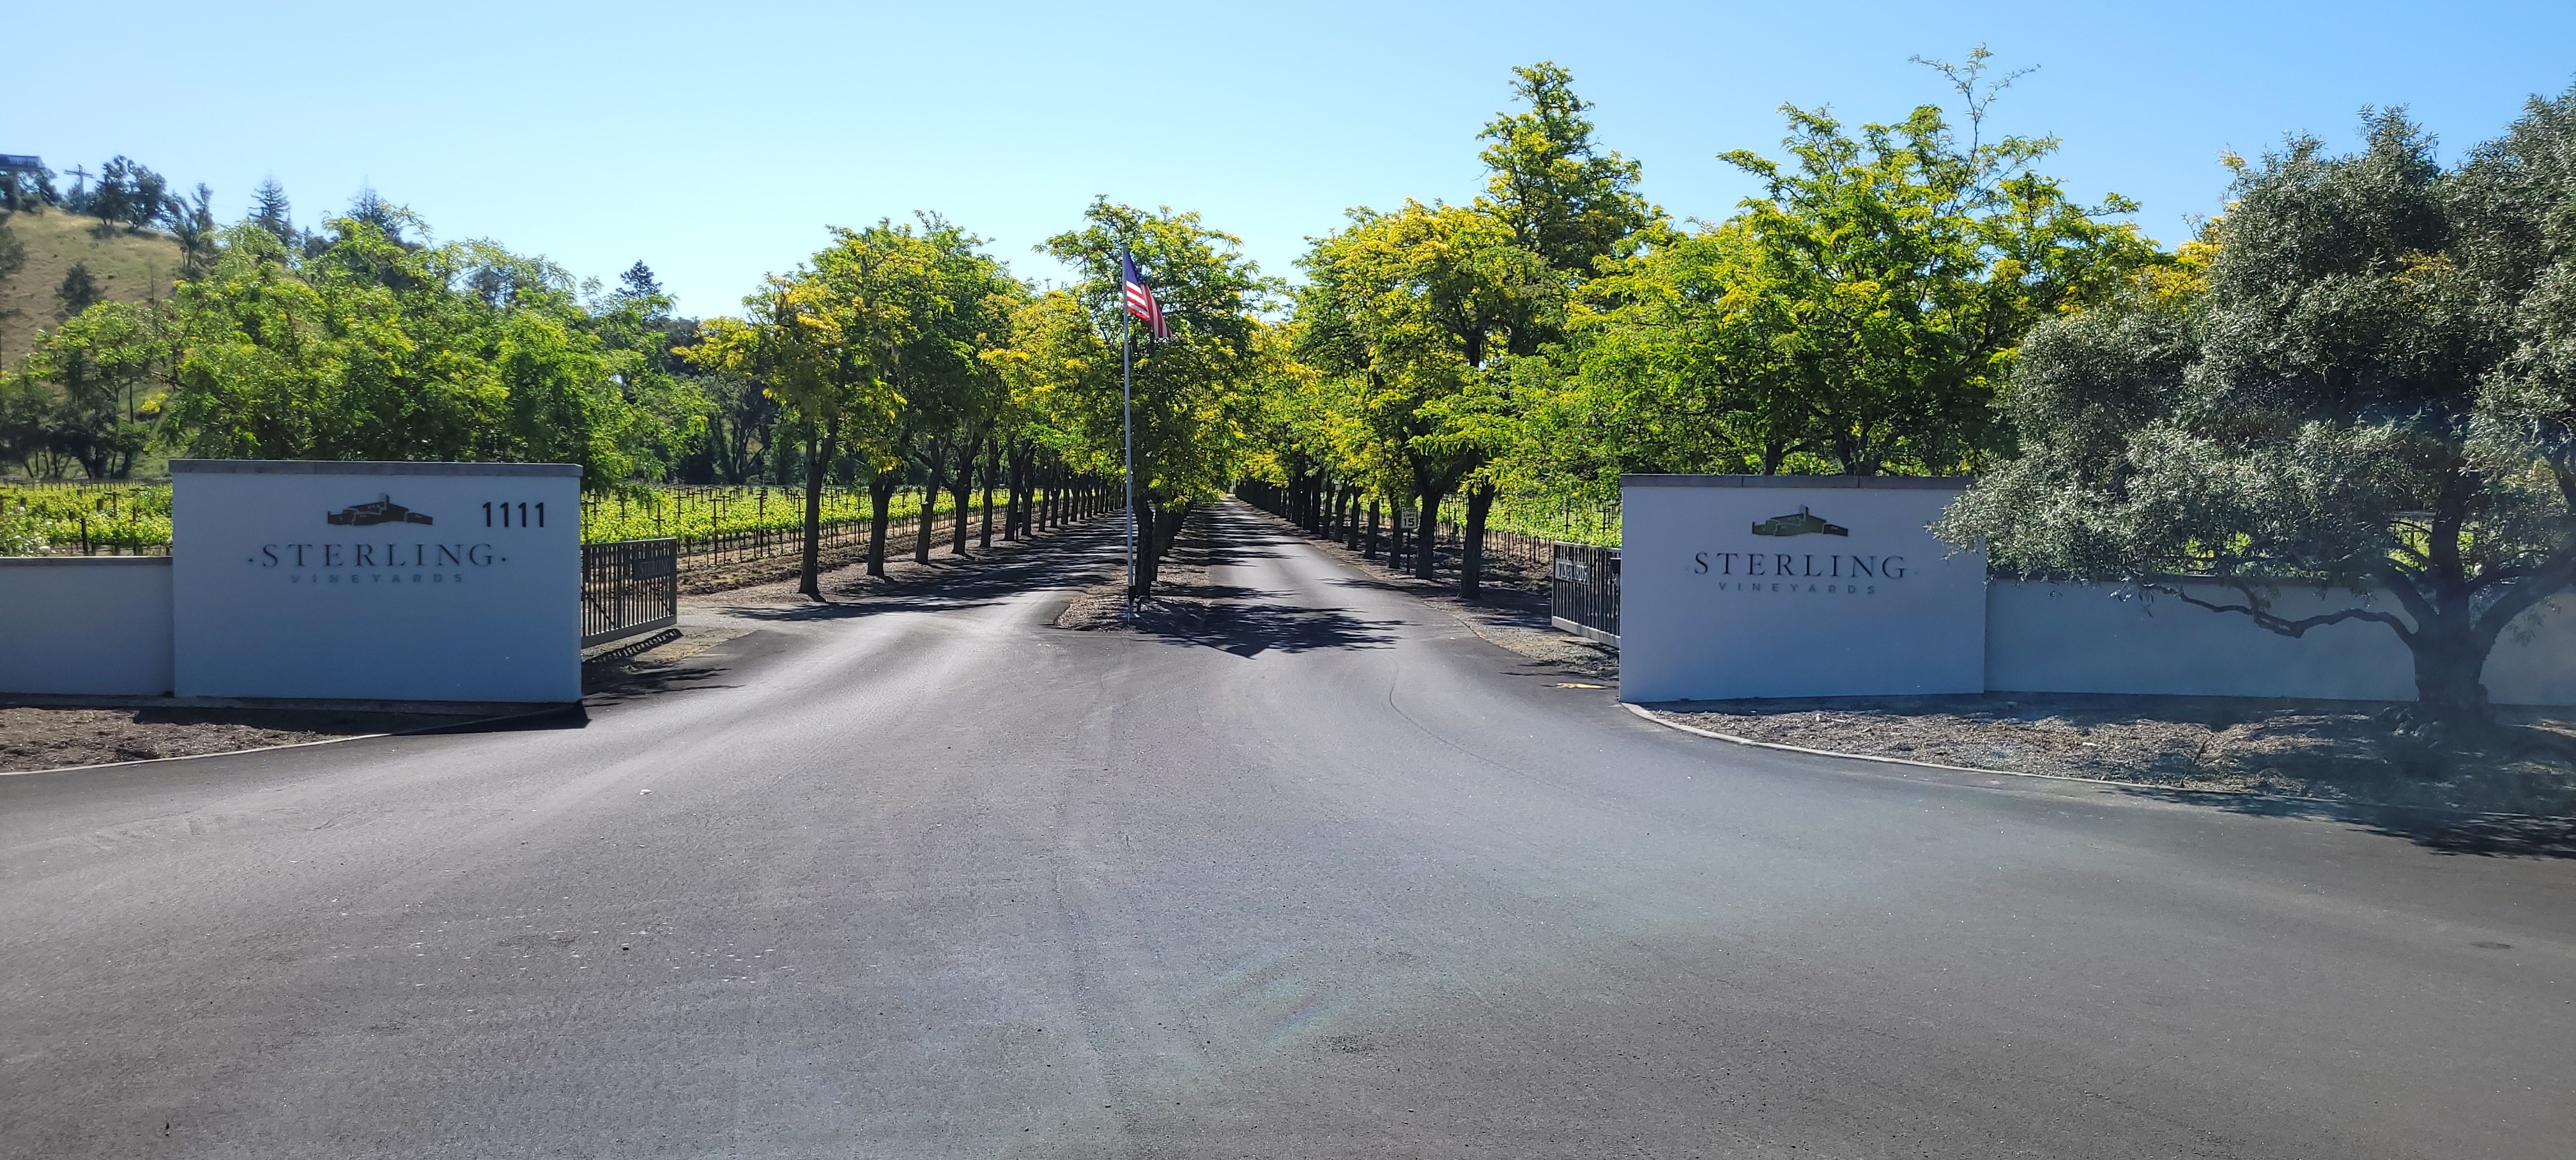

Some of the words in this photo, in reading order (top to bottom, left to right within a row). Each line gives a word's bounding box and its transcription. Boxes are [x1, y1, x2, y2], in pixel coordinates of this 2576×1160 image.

[482, 502, 544, 528] 1111
[1404, 518, 1415, 526] 15
[262, 543, 494, 567] STERLING
[1694, 551, 1907, 579] STERLING
[291, 574, 463, 584] VINEYARDS
[1719, 582, 1875, 595] VINEYARDS
